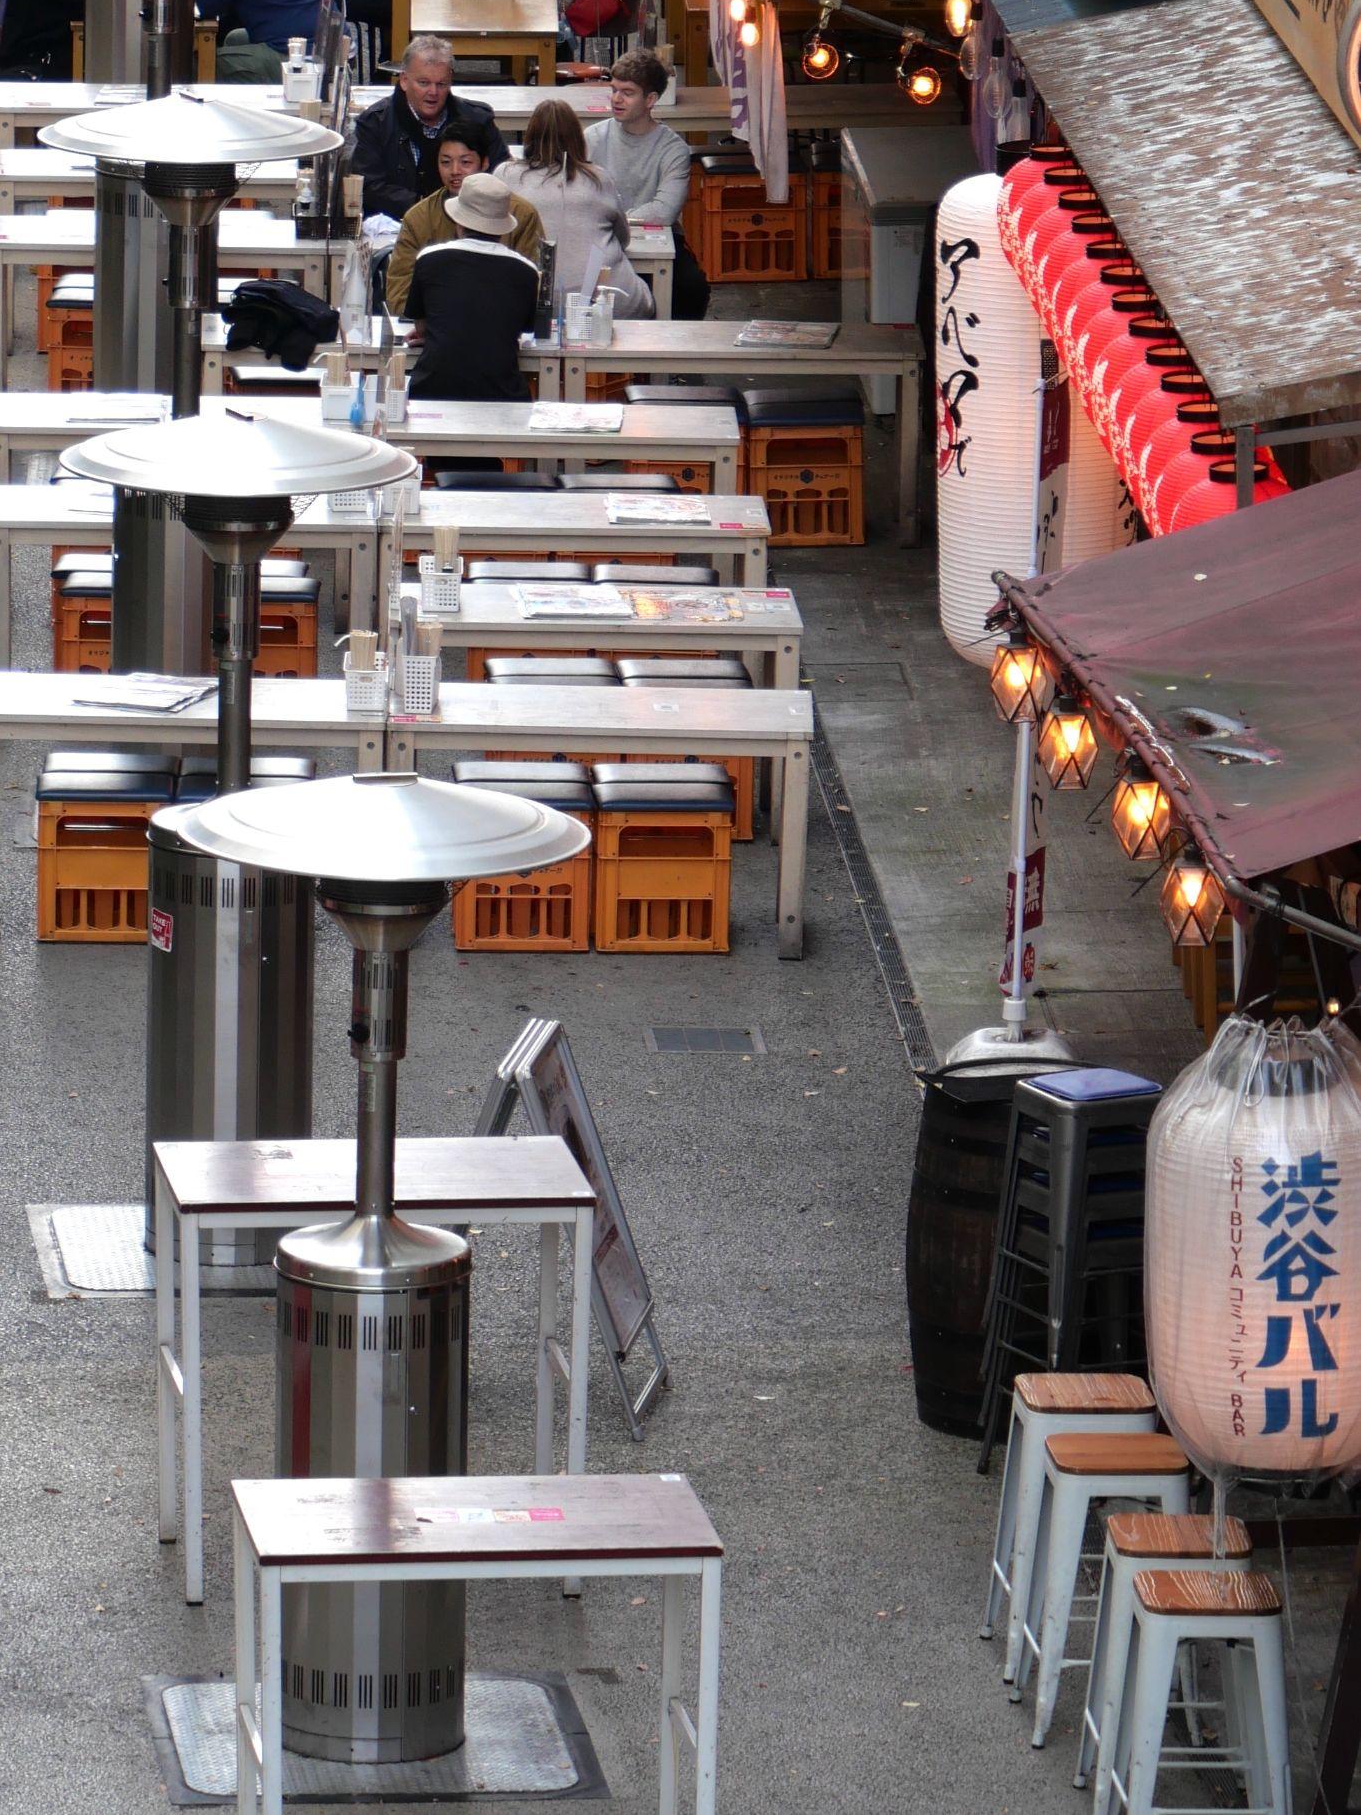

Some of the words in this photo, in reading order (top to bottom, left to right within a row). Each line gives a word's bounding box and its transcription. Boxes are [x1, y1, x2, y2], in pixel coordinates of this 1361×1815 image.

[1230, 1156, 1243, 1280] SHIBUYA
[1228, 1287, 1249, 1384] コミュニティ
[1256, 1149, 1342, 1439] 渋谷バル
[1230, 1393, 1246, 1438] BAR
